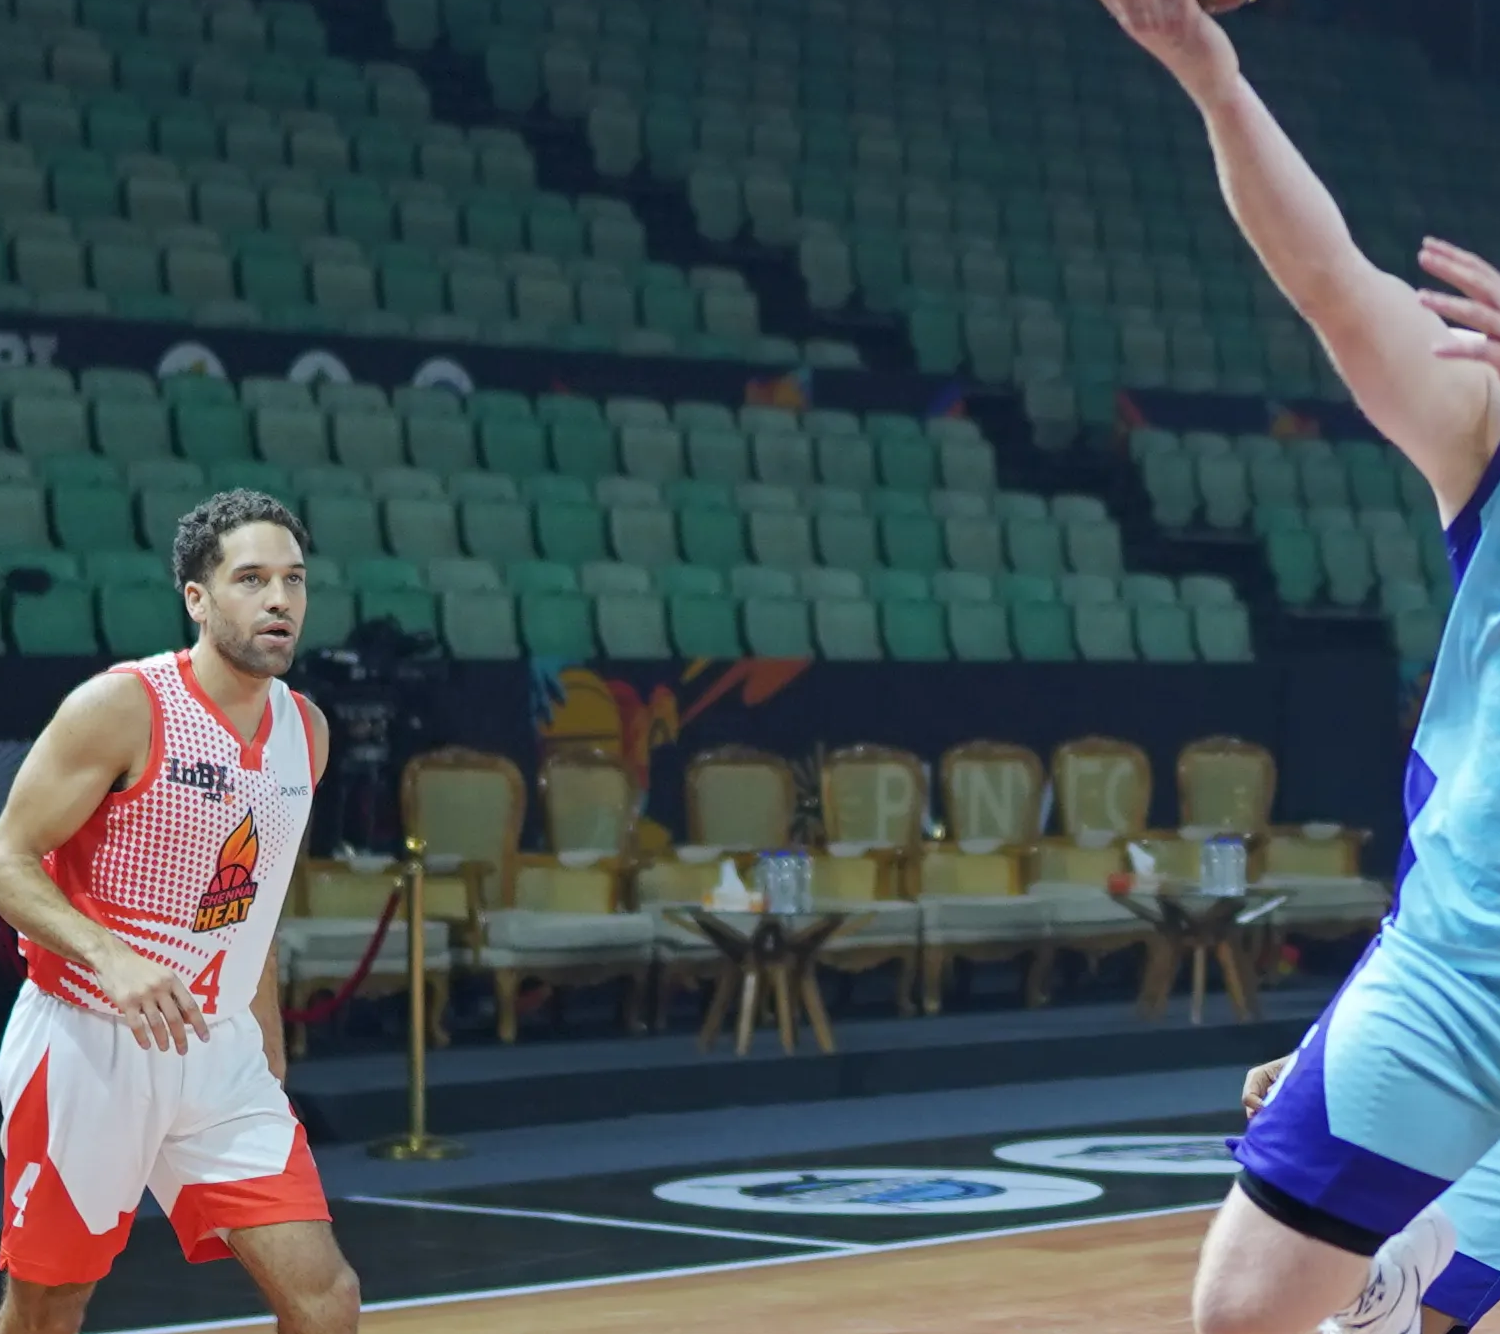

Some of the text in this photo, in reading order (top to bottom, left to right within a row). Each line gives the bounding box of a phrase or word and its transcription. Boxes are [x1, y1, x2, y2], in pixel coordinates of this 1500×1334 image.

[166, 757, 235, 793] InBL
[200, 884, 256, 907] CHENNAI
[194, 897, 253, 932] HEAT
[189, 950, 221, 1015] 4
